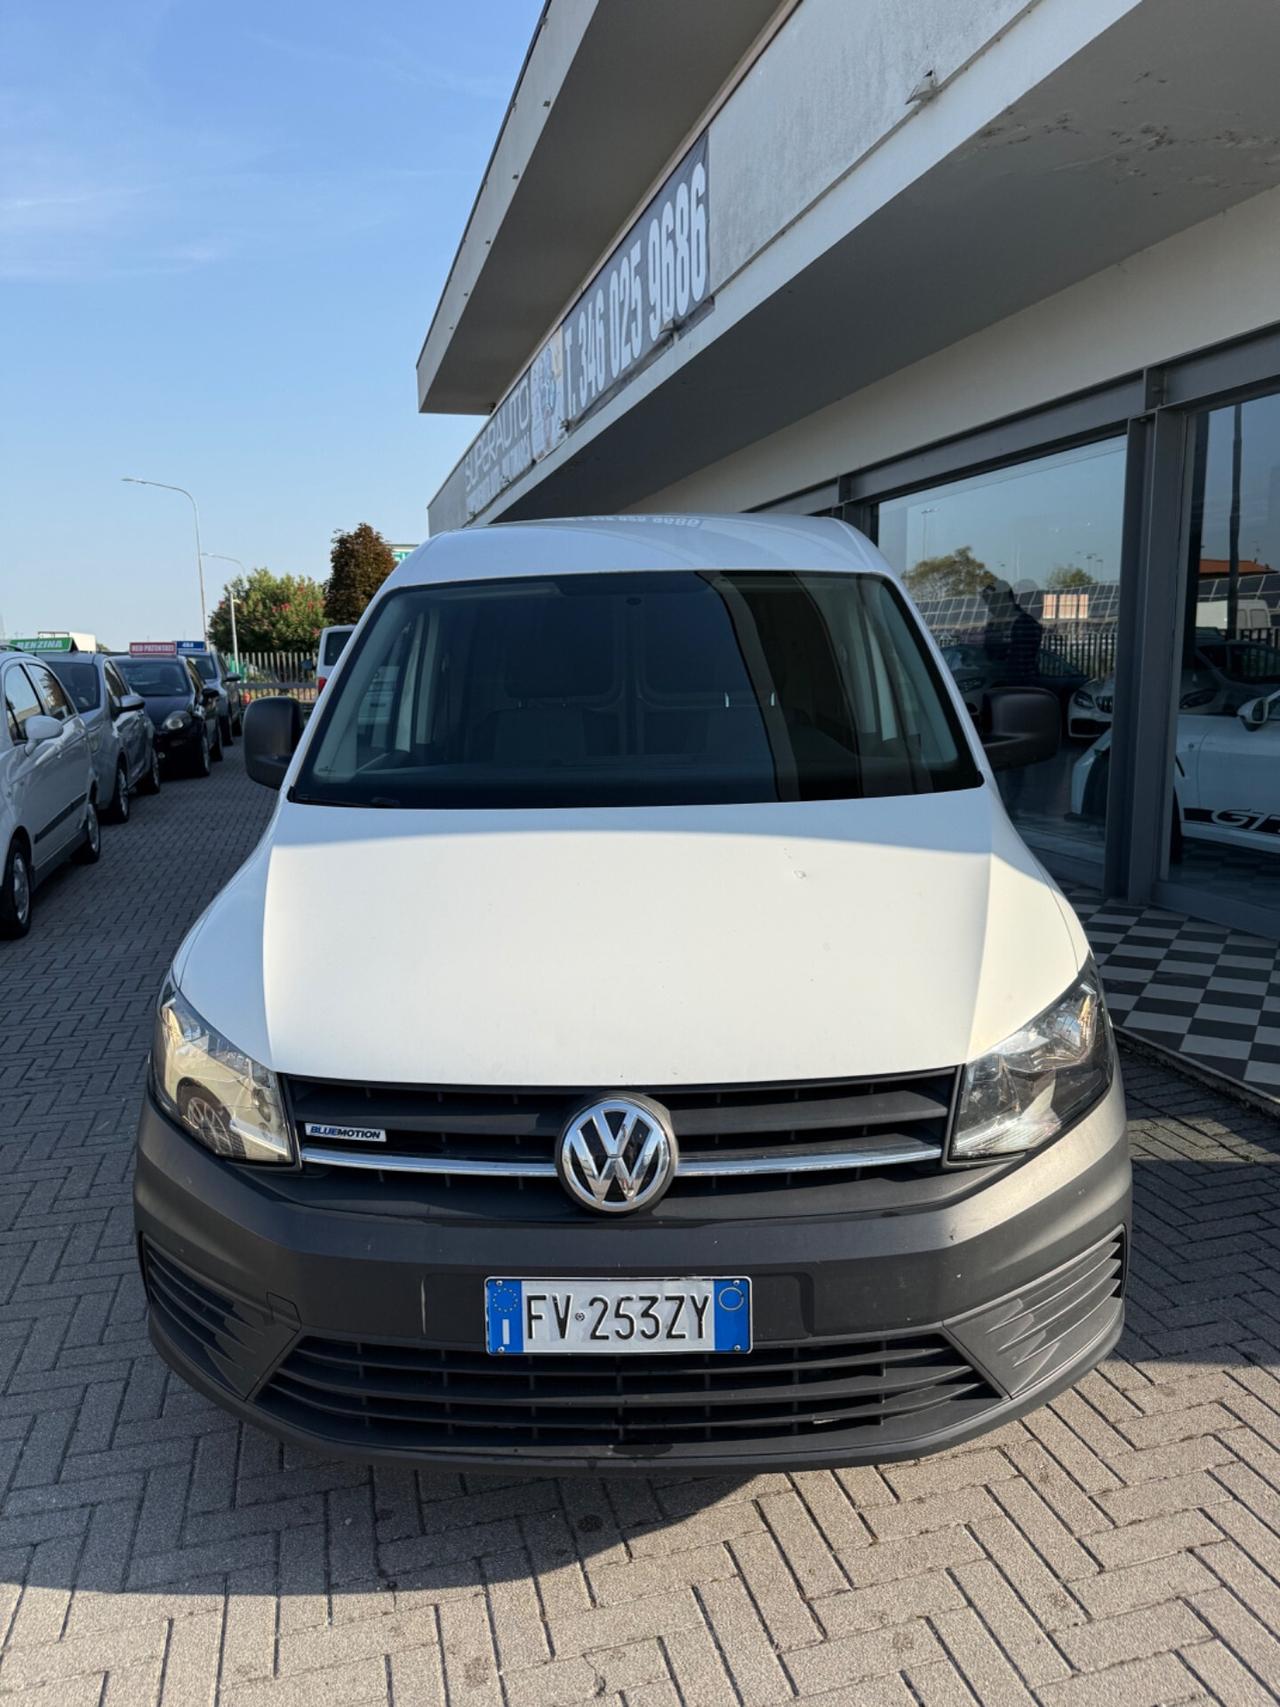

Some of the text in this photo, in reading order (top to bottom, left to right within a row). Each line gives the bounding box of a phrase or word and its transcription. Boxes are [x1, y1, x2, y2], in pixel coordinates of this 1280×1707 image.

[578, 289, 606, 408] 346
[609, 240, 642, 378] 025
[648, 162, 706, 341] 9686
[466, 381, 530, 492] SUPERAUTO
[16, 640, 63, 649] BENZINA
[1211, 808, 1280, 832] GT
[310, 1126, 381, 1139] BLUEMOTION
